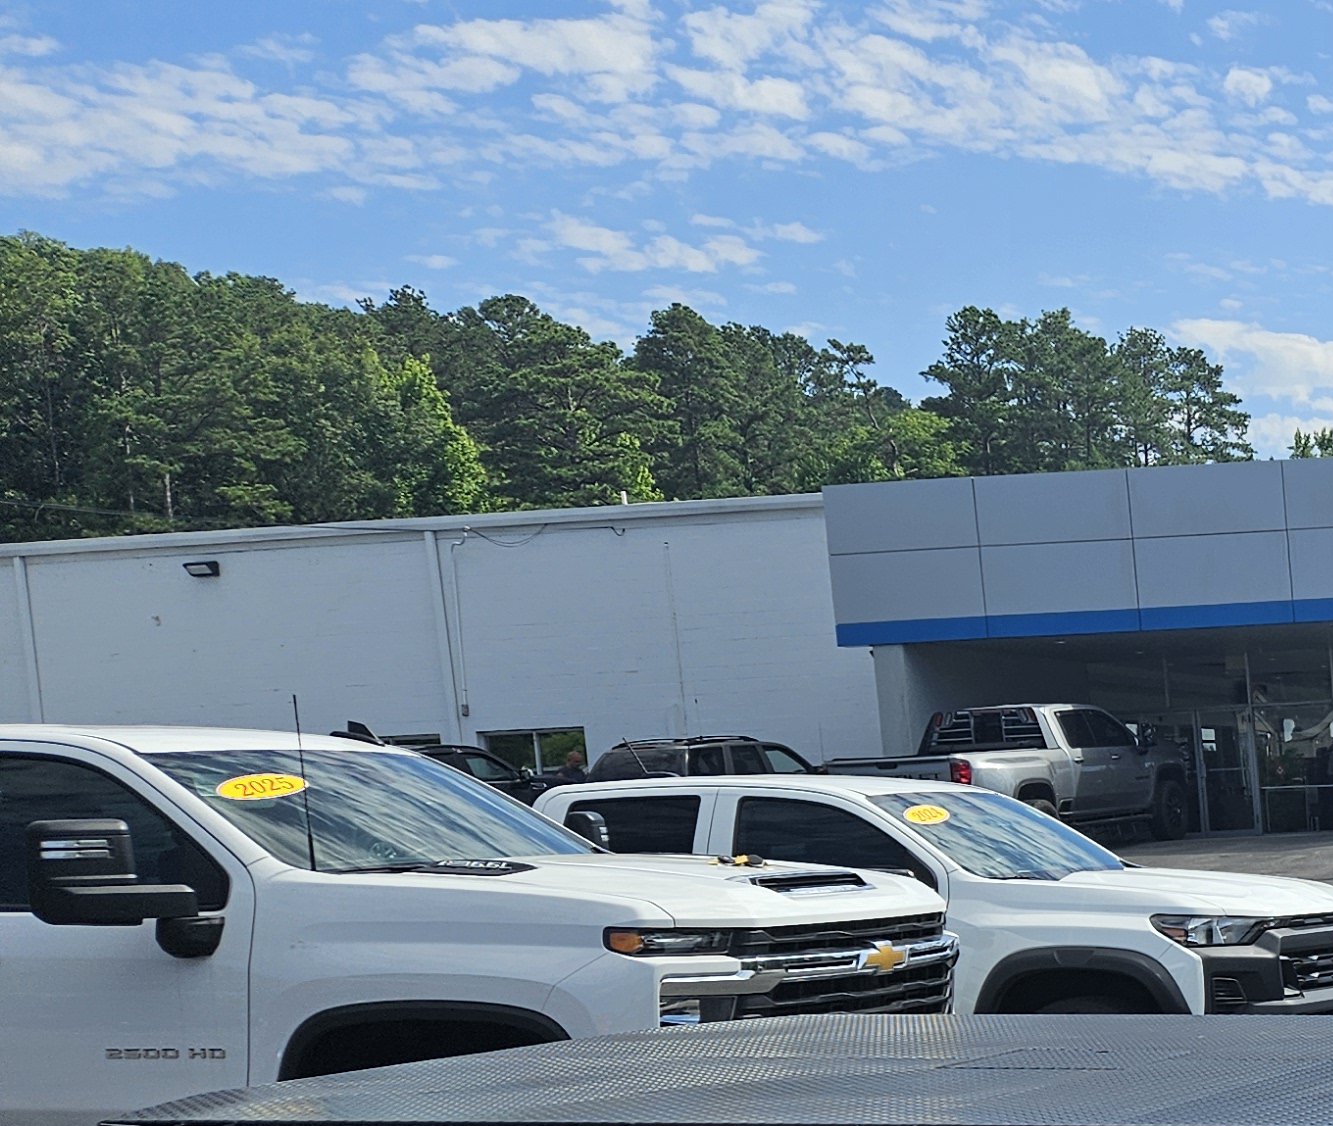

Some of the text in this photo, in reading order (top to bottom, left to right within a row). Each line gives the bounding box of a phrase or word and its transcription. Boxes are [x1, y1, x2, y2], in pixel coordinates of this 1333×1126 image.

[234, 776, 295, 797] 2025
[104, 1047, 227, 1060] 2500 HD
